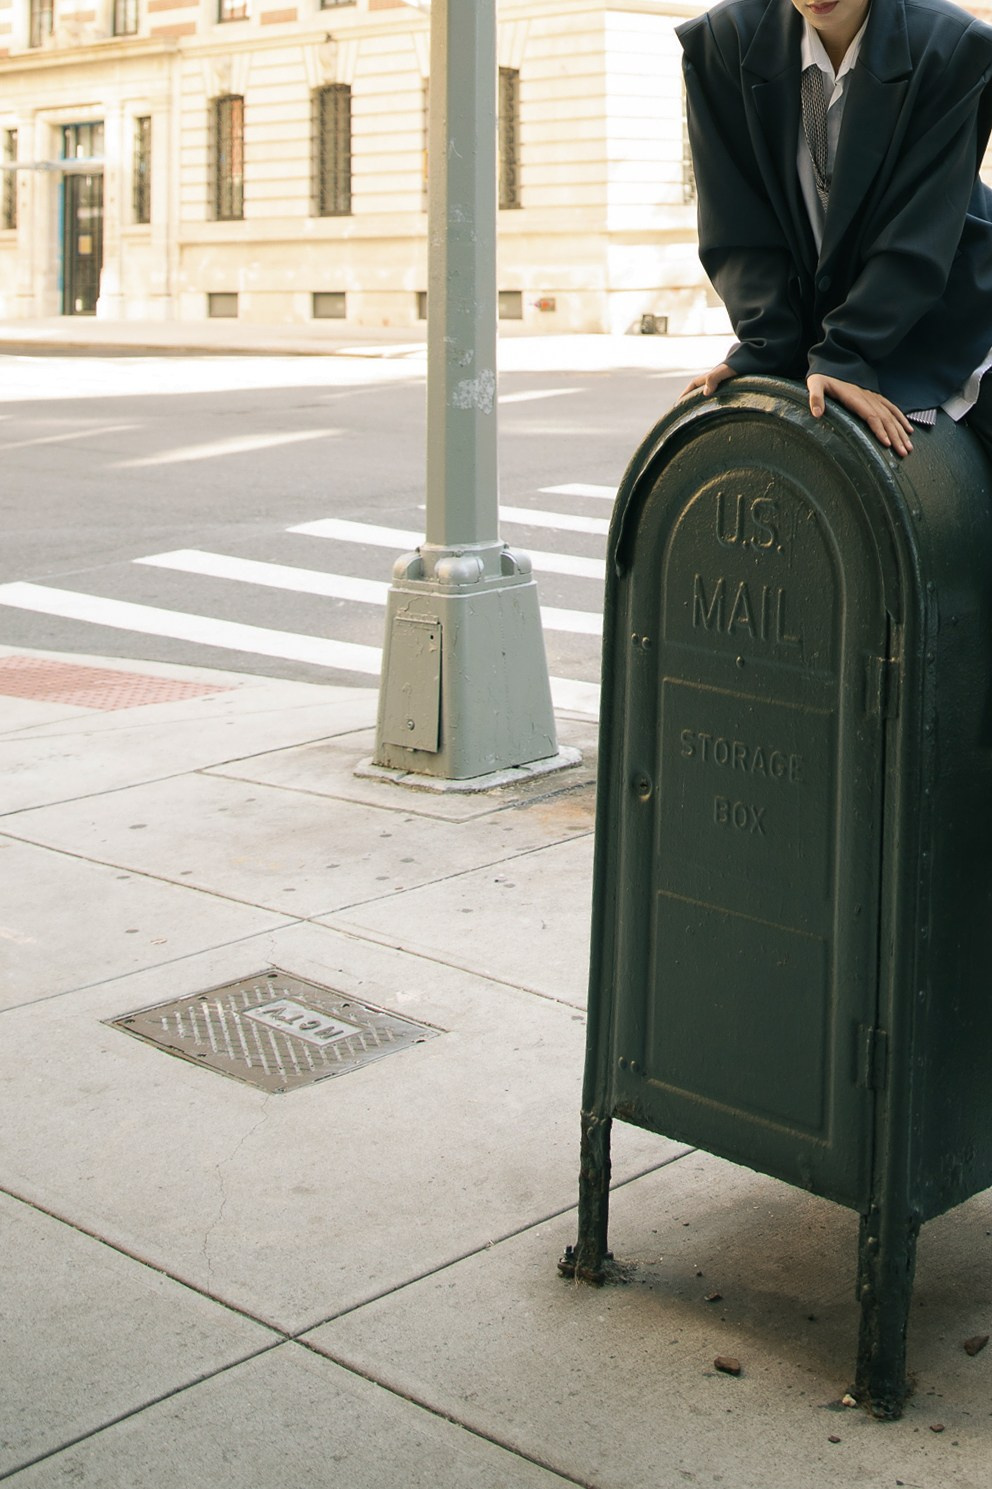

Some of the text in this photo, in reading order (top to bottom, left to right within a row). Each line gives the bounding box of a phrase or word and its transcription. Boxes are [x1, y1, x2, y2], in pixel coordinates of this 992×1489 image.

[715, 491, 785, 554] U.S.
[692, 573, 800, 649] MAIL
[680, 729, 803, 783] STORAGE
[713, 796, 767, 836] BOX
